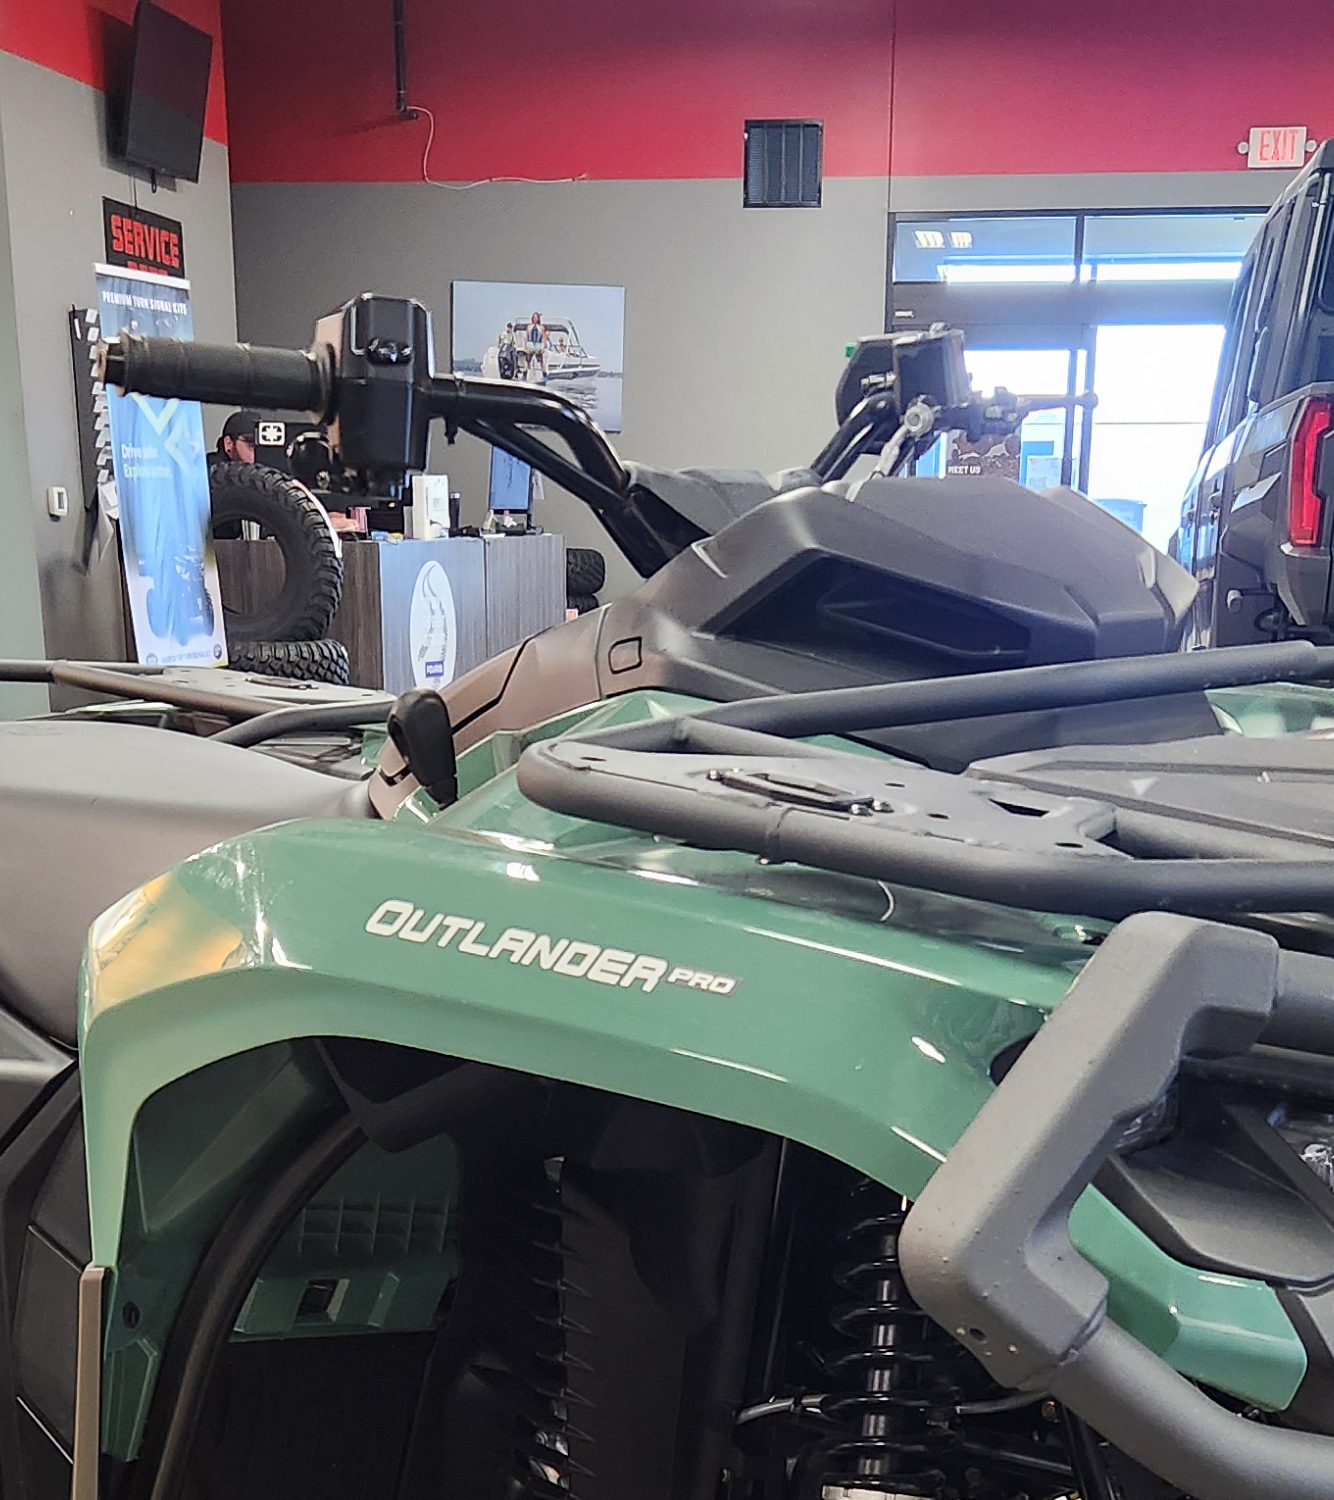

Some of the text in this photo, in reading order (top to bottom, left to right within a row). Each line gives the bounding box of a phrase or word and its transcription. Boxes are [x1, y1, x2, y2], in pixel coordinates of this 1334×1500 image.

[1259, 129, 1299, 162] EXIT
[110, 214, 179, 269] SERVICE
[365, 899, 736, 995] OUTLANDER PRO
